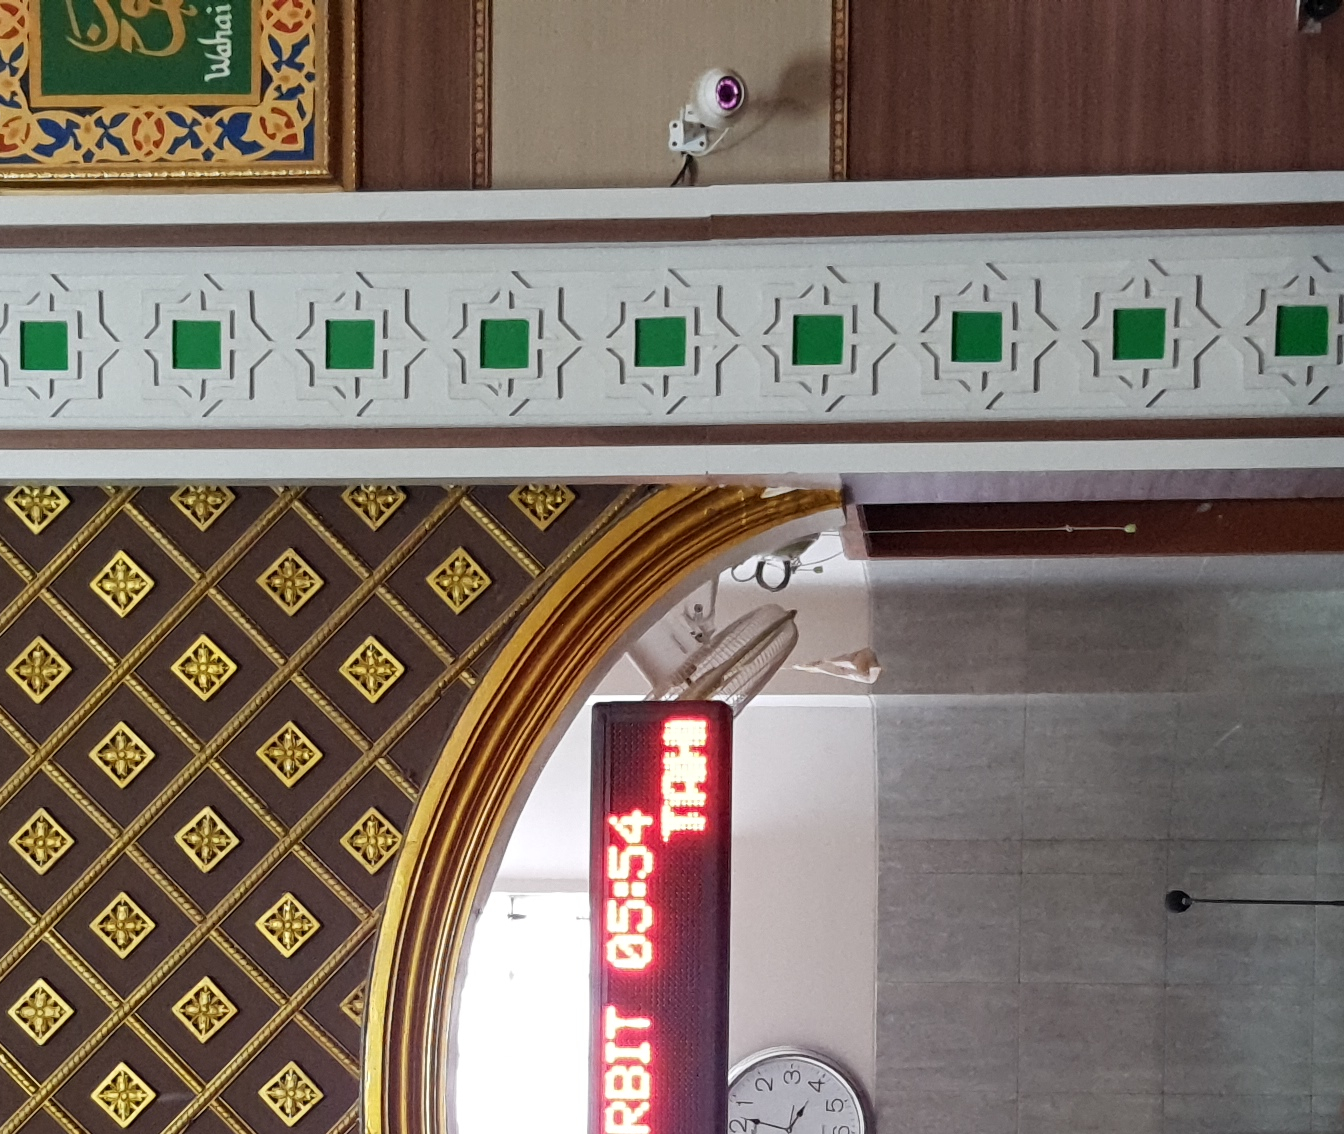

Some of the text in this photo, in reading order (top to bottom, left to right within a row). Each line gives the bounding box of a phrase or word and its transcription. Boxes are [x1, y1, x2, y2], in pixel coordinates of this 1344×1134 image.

[197, 4, 232, 82] Wahai
[605, 810, 653, 971] 05:54
[784, 1070, 801, 1084] 3
[756, 1078, 773, 1092] 2
[808, 1079, 824, 1092] 4
[826, 1098, 844, 1112] 5
